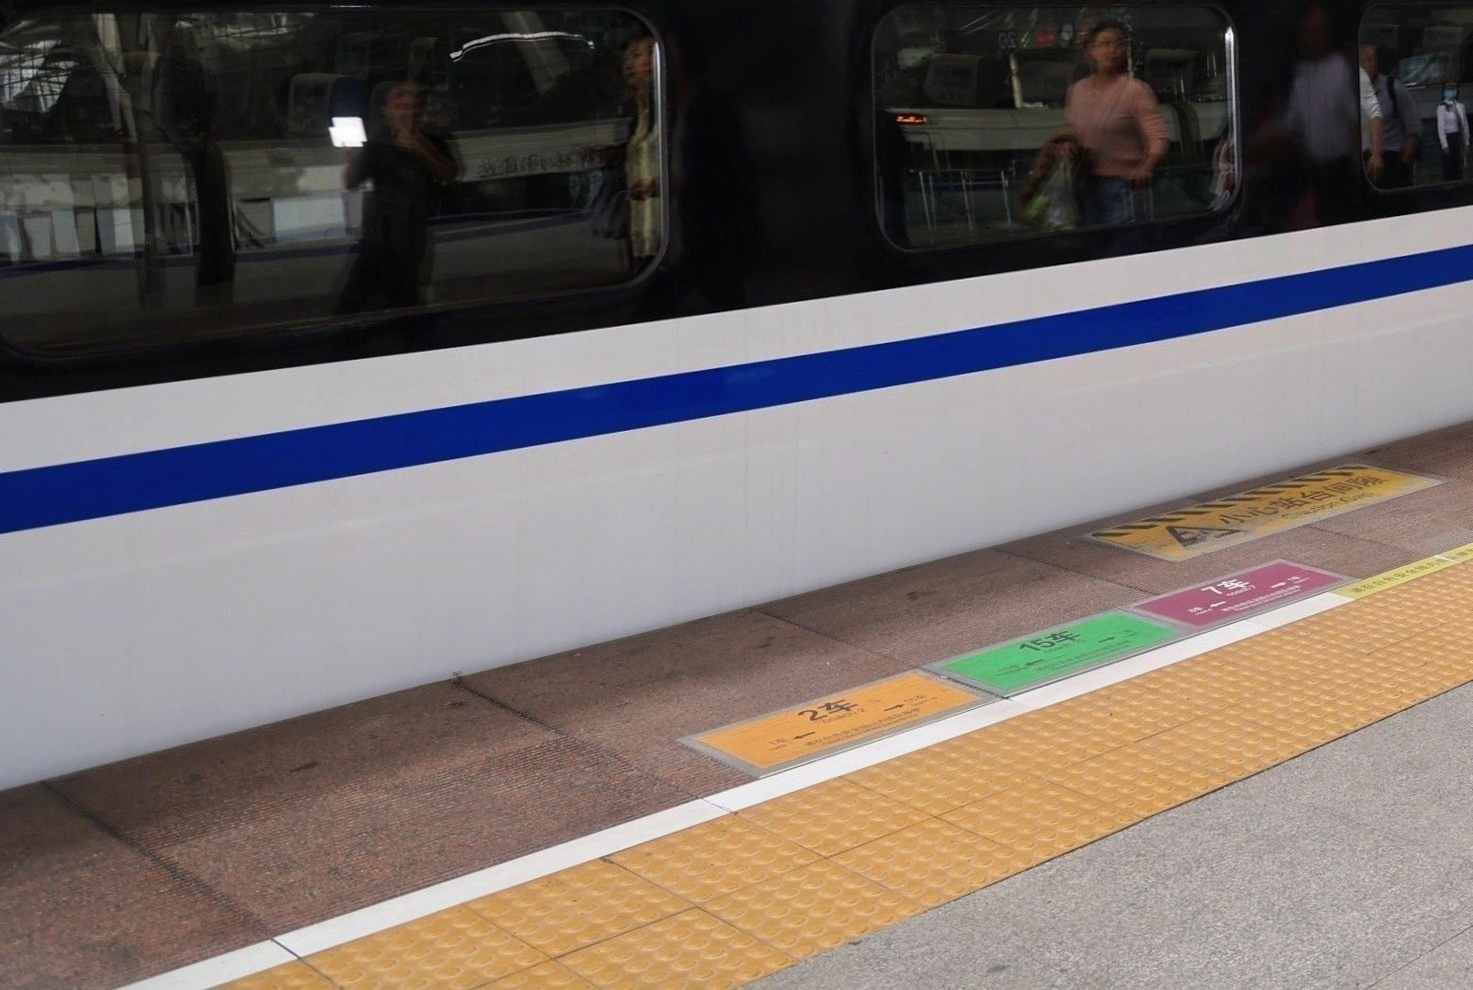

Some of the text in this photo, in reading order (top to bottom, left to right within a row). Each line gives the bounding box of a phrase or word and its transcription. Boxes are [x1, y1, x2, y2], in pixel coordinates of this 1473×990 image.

[1219, 475, 1389, 525] 小心站台间隙
[1200, 578, 1250, 595] 7车
[1019, 630, 1081, 652] 15车
[797, 699, 859, 721] 2车
